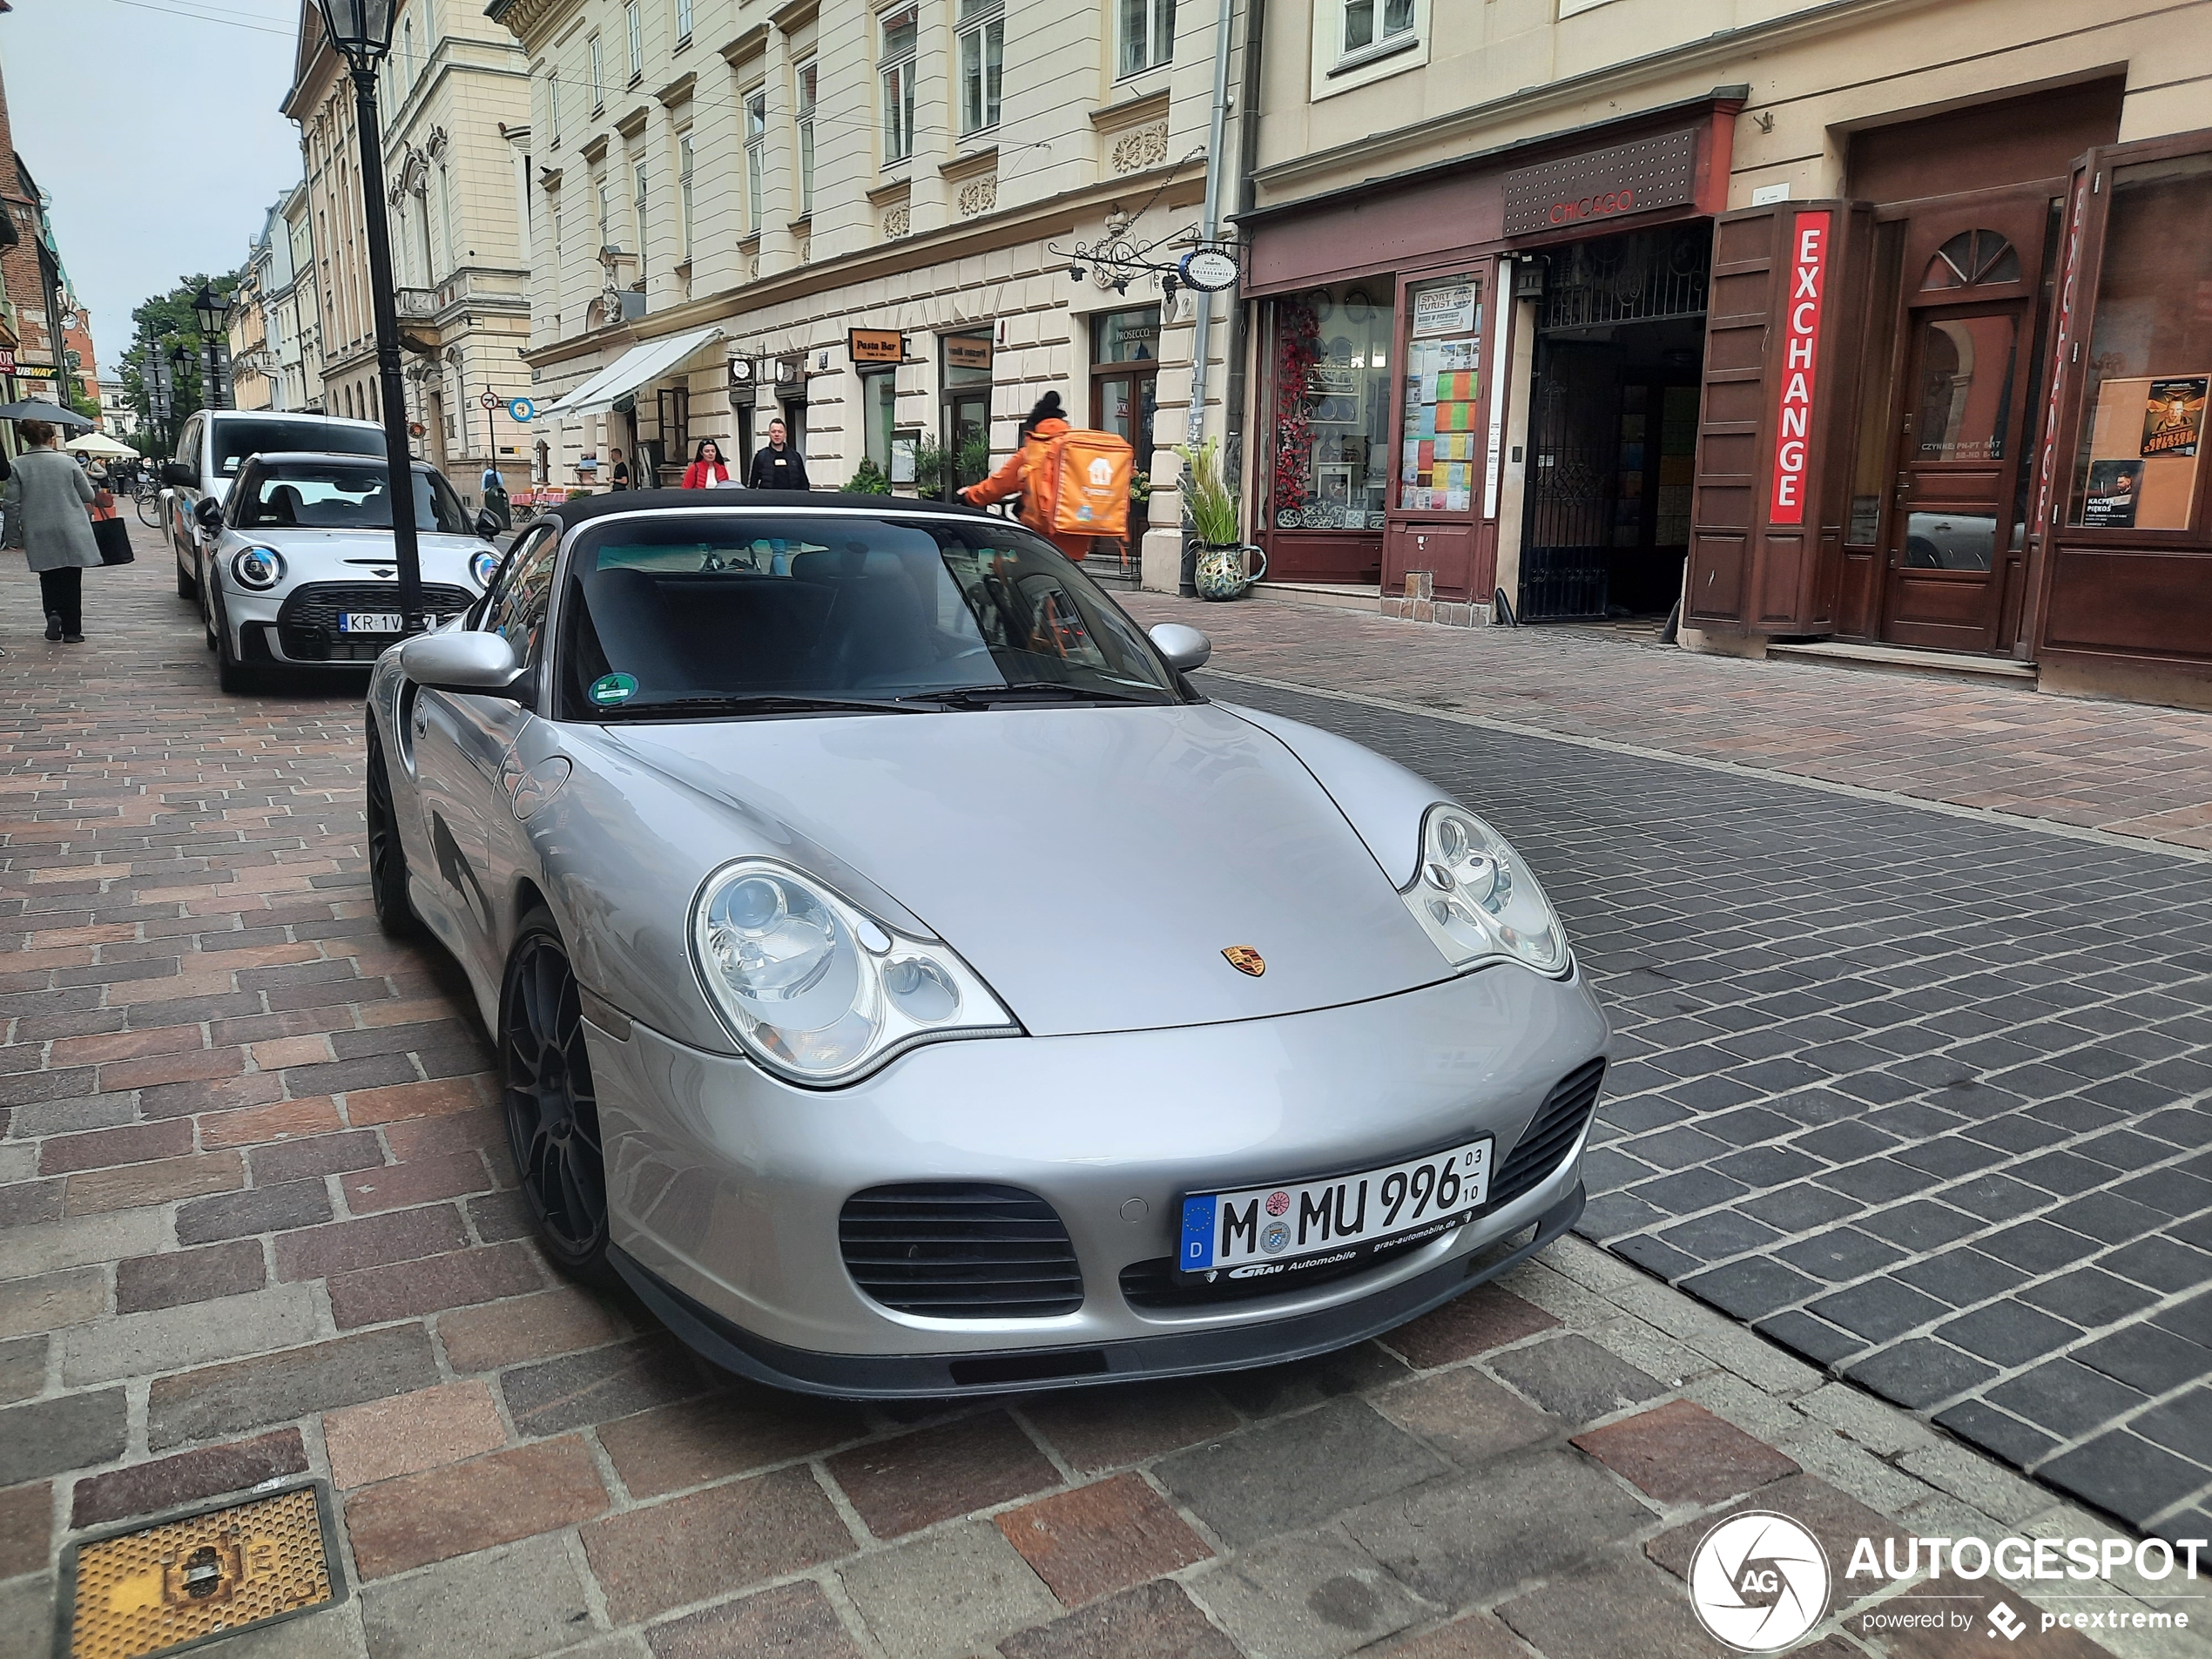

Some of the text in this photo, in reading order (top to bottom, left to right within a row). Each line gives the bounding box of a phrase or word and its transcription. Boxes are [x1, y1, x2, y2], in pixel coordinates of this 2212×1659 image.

[1549, 189, 1634, 224] CHICAGO
[1420, 300, 1452, 312] TURIST
[1421, 292, 1452, 304] SPORT
[856, 340, 896, 351] Pasta Bar
[15, 366, 57, 377] UBWAY
[1778, 228, 1822, 507] EXCHANGE
[1956, 442, 1979, 450] PN-PT
[2087, 504, 2112, 514] PIĘKOŚ
[351, 615, 433, 631] KR 1V7
[609, 677, 620, 690] 4
[1465, 1148, 1482, 1167] 03
[1462, 1184, 1479, 1204] 10
[1221, 1198, 1259, 1258] M
[1297, 1179, 1368, 1246] MU
[1381, 1156, 1462, 1228] 996
[1372, 1218, 1457, 1254] grau-automobile.de
[1190, 1242, 1203, 1258] D
[1288, 1250, 1357, 1271] Automobile
